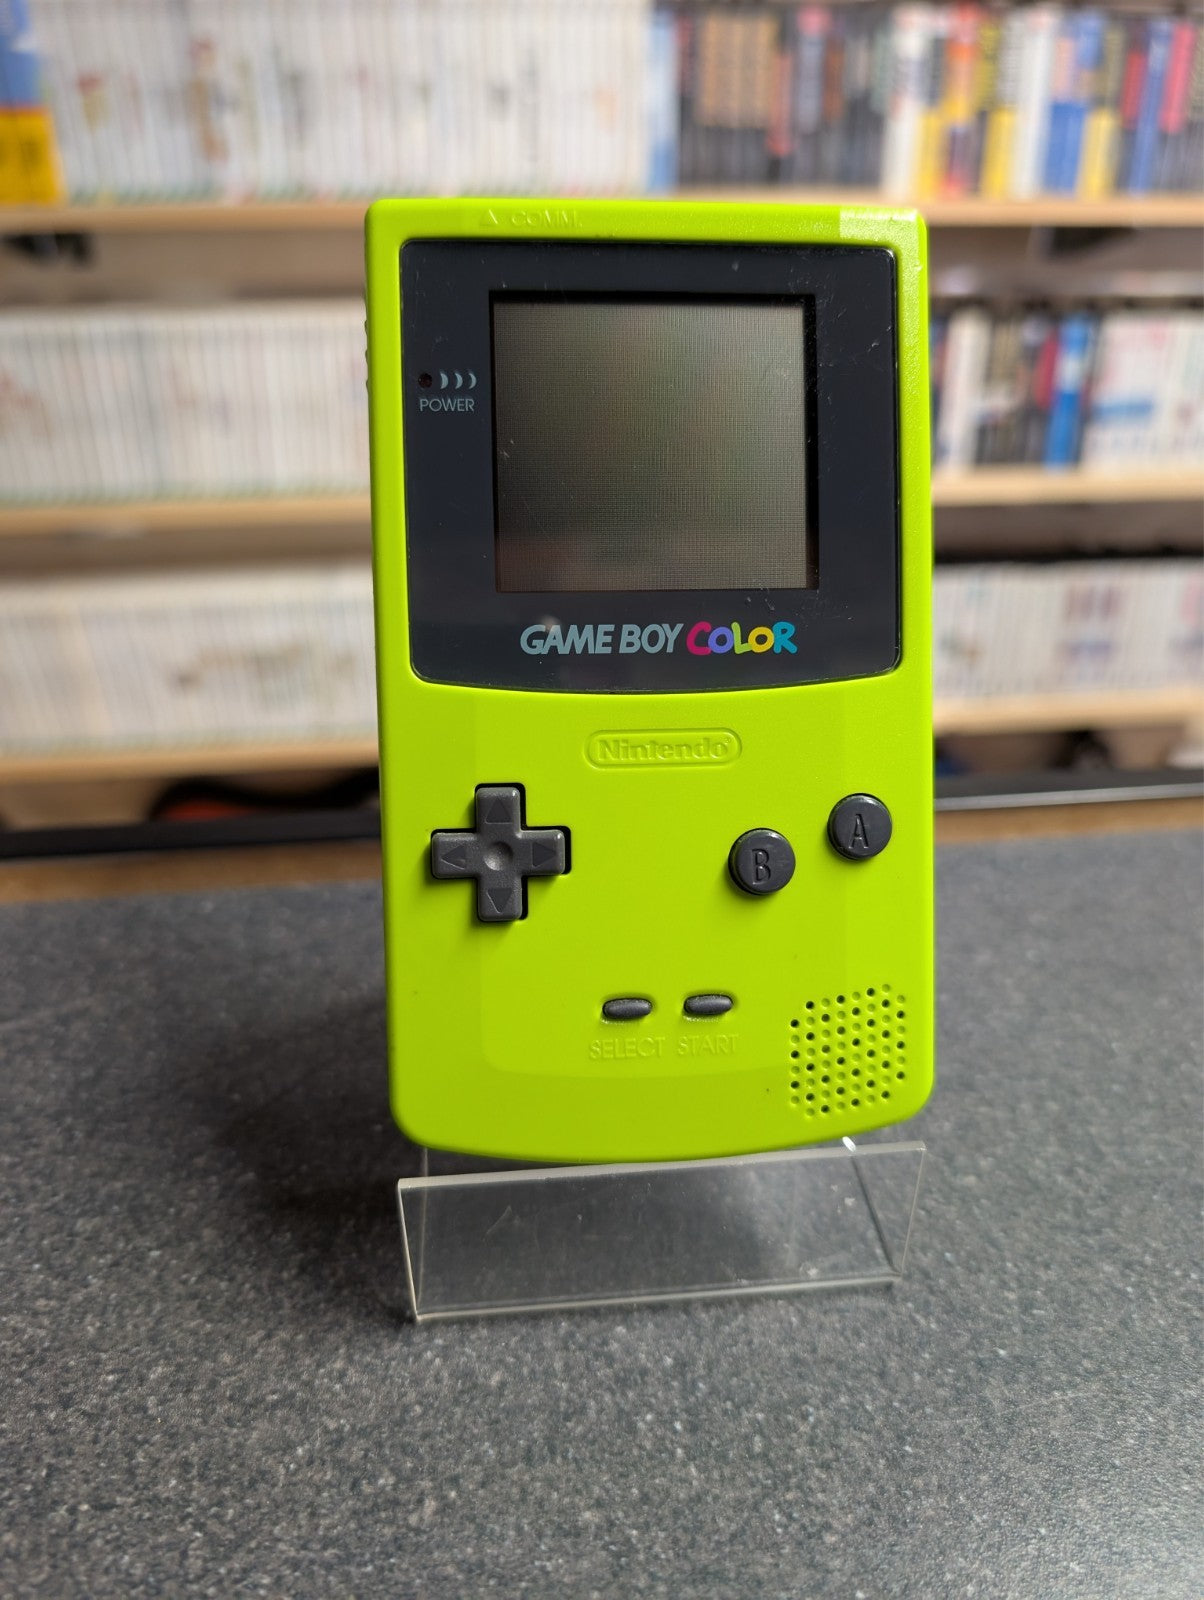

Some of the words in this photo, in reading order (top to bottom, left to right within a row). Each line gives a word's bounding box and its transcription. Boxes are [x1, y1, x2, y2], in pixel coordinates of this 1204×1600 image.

[419, 398, 475, 412] POWER
[519, 623, 613, 655] GAME
[618, 623, 684, 654] BOY
[686, 621, 798, 656] COLOR
[598, 737, 729, 761] Nintendo
[848, 813, 869, 849] A
[752, 848, 771, 885] B
[589, 1036, 666, 1059] SELECT
[677, 1033, 739, 1056] START
